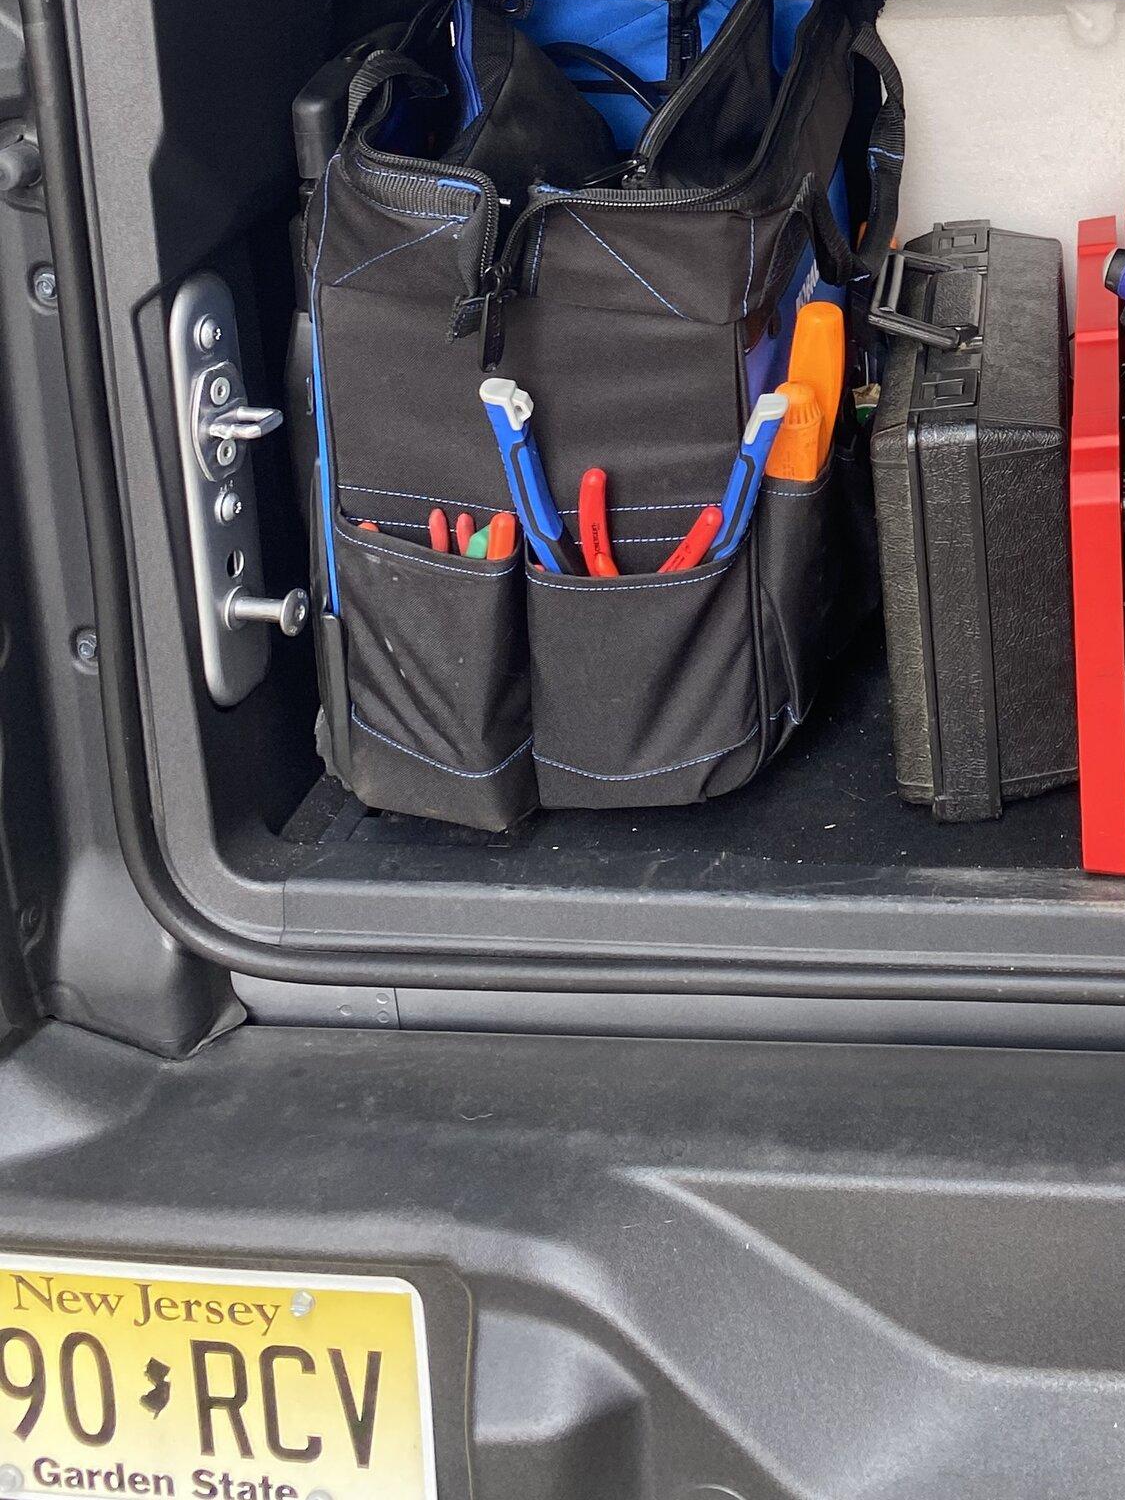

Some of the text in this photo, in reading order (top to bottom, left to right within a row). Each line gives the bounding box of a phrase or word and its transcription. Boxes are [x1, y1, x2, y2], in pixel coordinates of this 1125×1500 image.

[9, 1273, 283, 1337] New Jersey
[190, 1337, 383, 1470] RCV
[32, 1456, 299, 1500] Garden State
